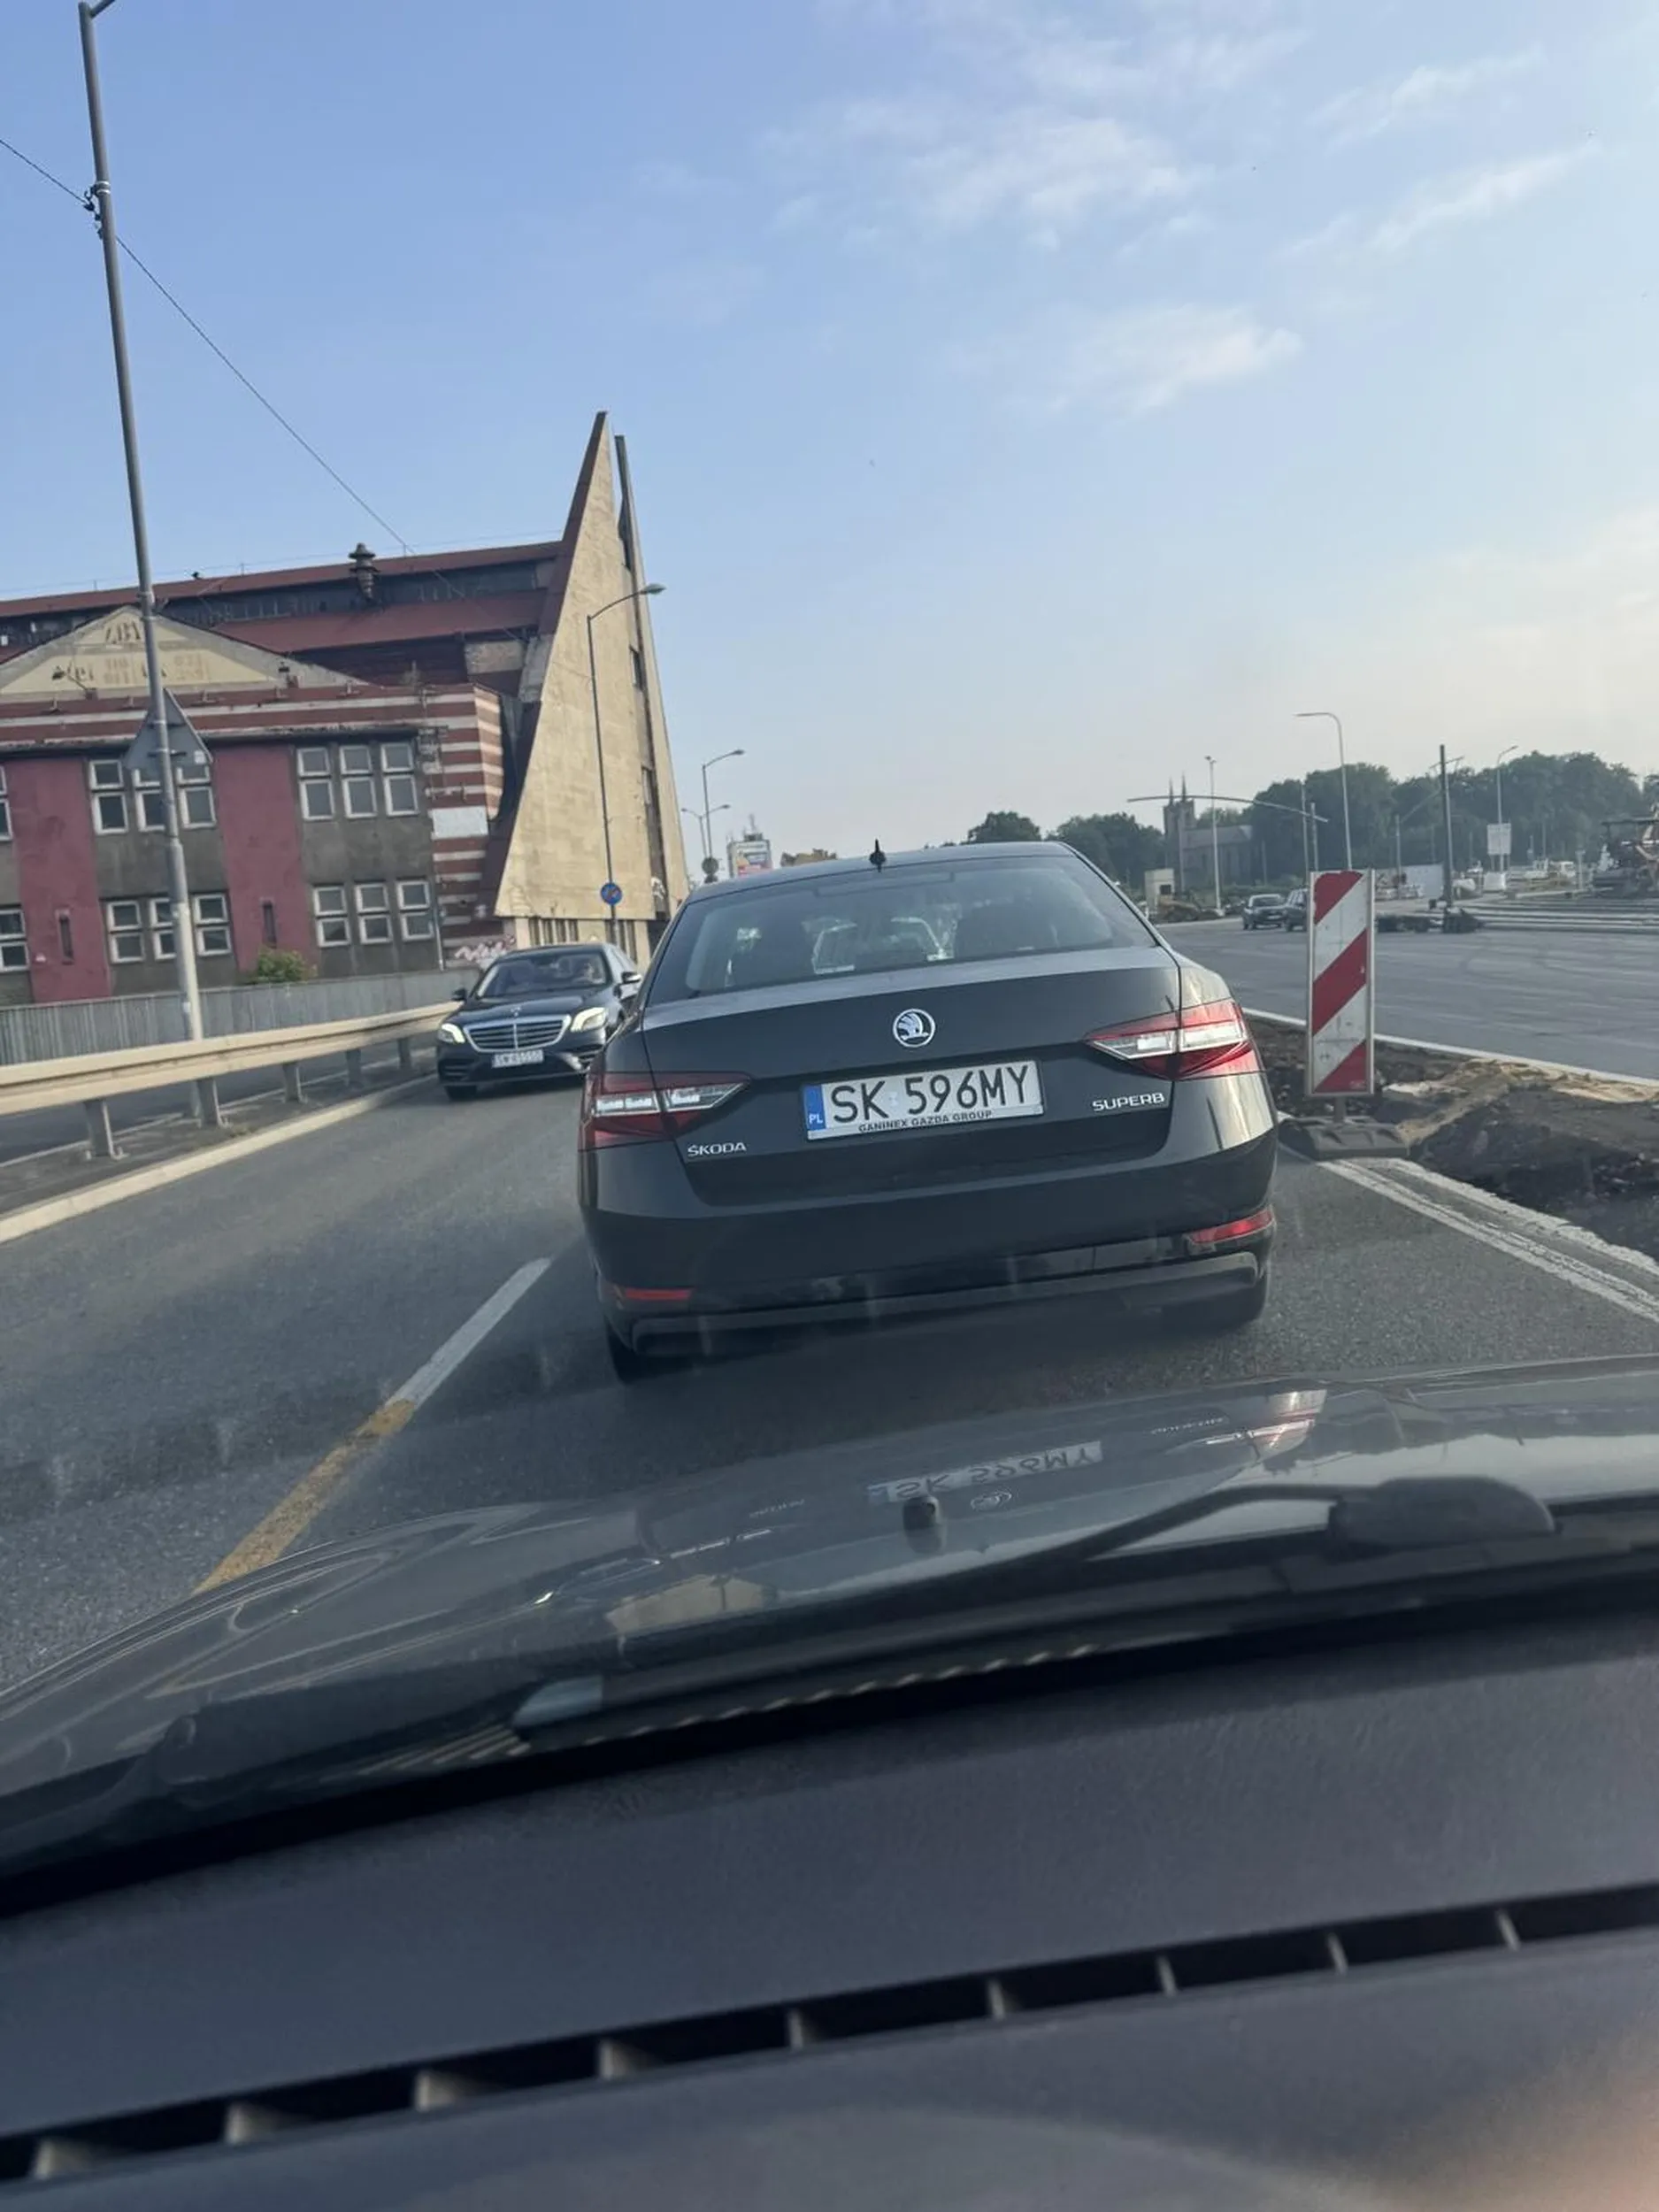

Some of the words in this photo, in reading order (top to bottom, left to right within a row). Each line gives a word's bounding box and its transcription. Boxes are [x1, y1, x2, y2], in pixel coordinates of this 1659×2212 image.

[831, 1080, 889, 1124] SK
[904, 1064, 1028, 1116] 596MY
[1092, 1091, 1165, 1111] SUPERB
[809, 1113, 824, 1125] PL
[858, 1118, 908, 1133] GANINEX
[911, 1113, 950, 1127] GAZDA
[952, 1109, 993, 1122] GROUP
